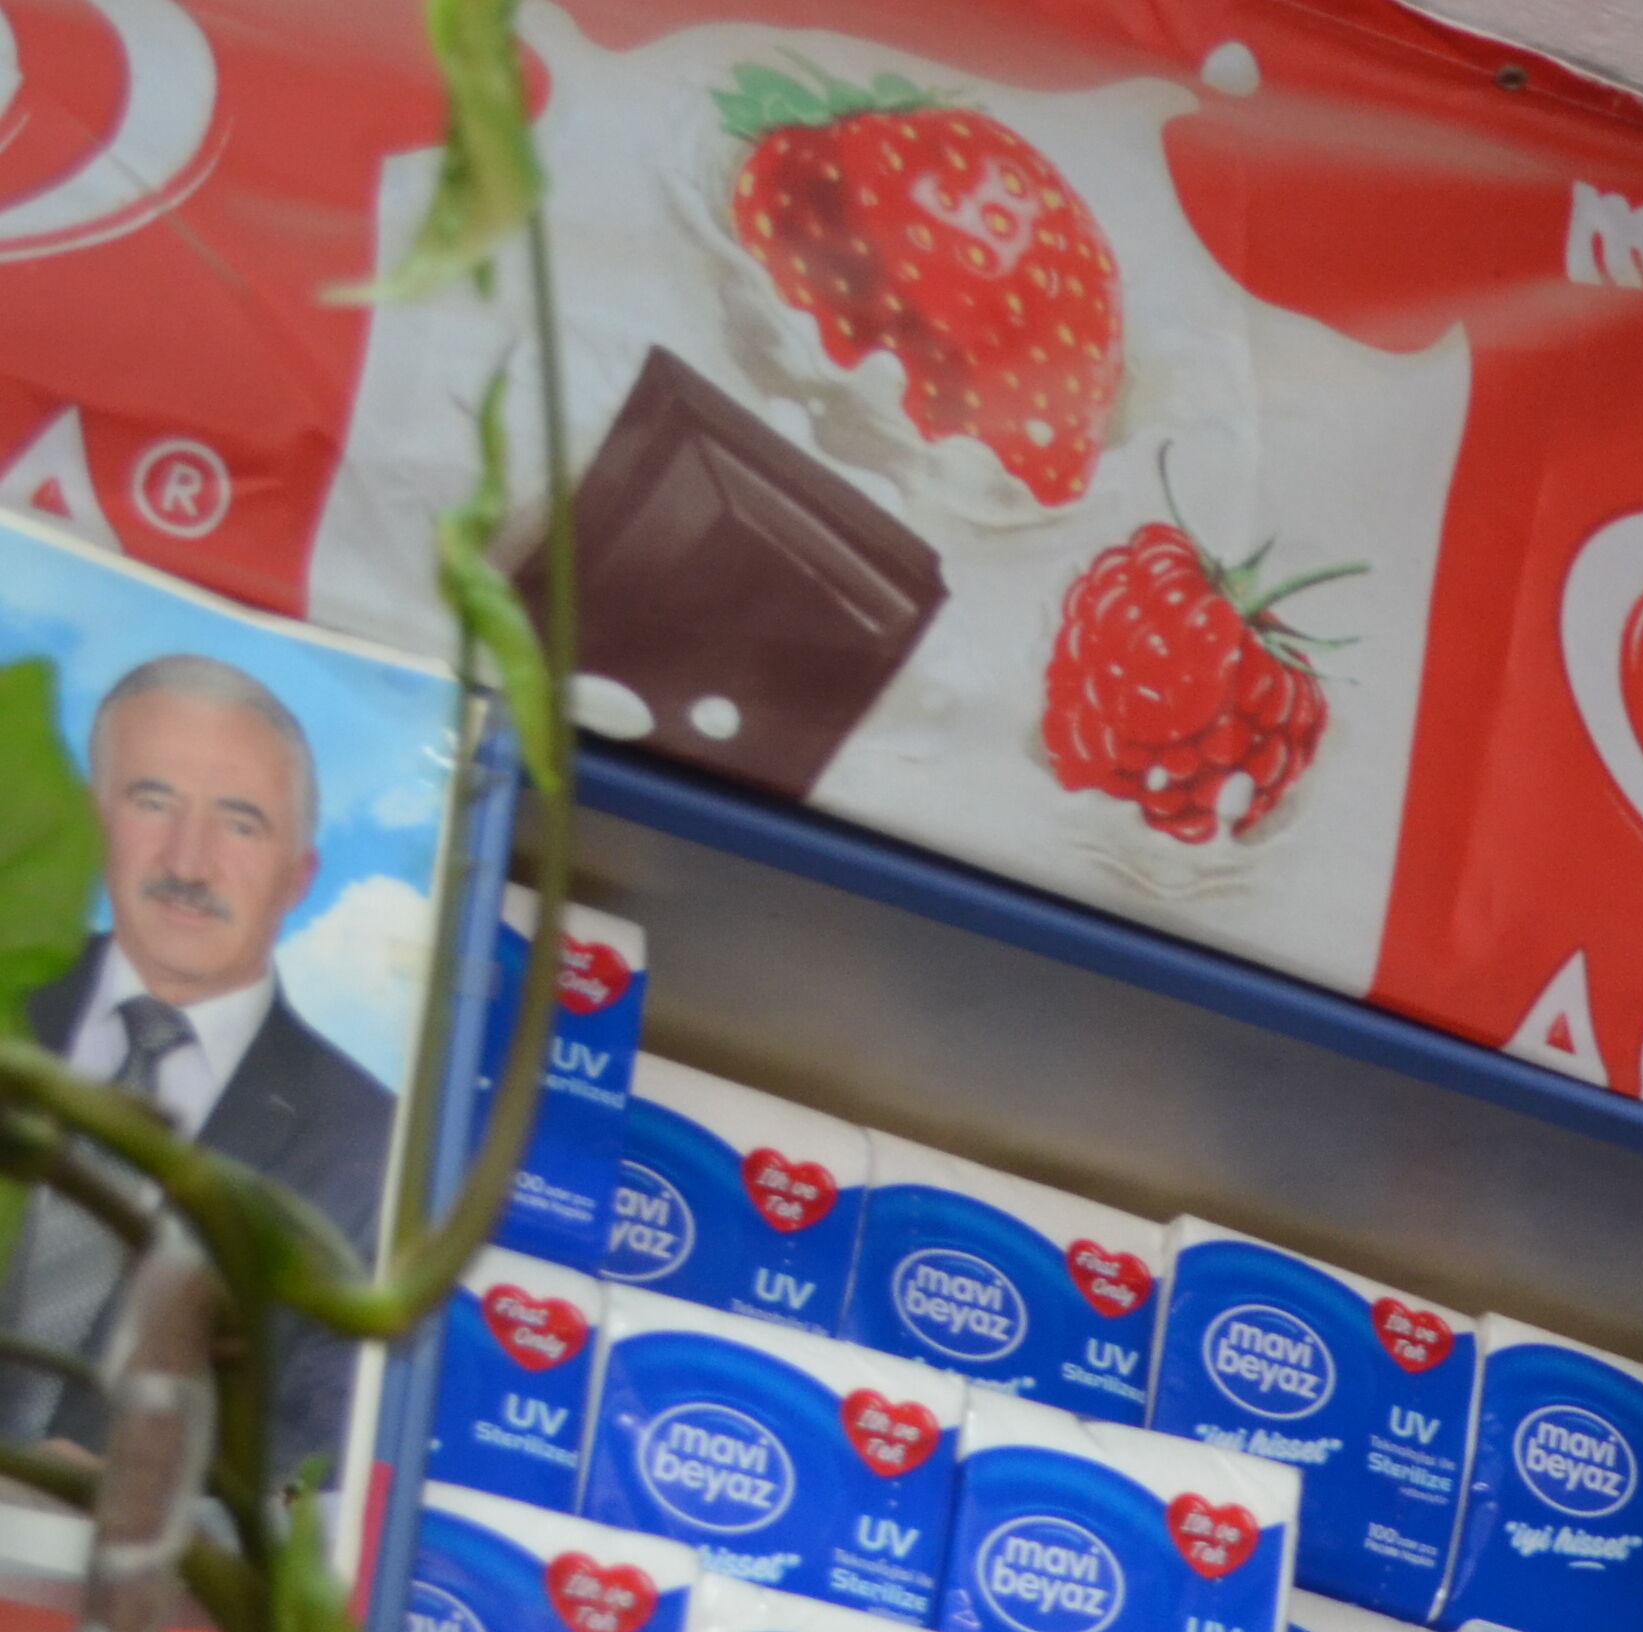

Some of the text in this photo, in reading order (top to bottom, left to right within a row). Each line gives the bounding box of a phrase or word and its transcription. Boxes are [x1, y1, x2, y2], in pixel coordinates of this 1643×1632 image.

[552, 1035, 611, 1079] UV
[615, 1186, 672, 1227] avi
[609, 1220, 676, 1259] yaz
[755, 1267, 818, 1310] UV
[905, 1278, 1014, 1344] beyaz
[914, 1262, 1006, 1313] mavi
[1085, 1337, 1139, 1377] UV
[1228, 1318, 1313, 1369] mavi
[1216, 1345, 1322, 1400] beyaz
[505, 1392, 570, 1437] UV
[1390, 1404, 1441, 1444] UV
[669, 1421, 770, 1474] mavi
[1535, 1417, 1618, 1470] mavi
[652, 1440, 778, 1509] beyaz
[1525, 1444, 1623, 1501] beyaz
[856, 1514, 921, 1558] UV
[1004, 1533, 1101, 1585] mavi
[991, 1554, 1108, 1617] beyaz
